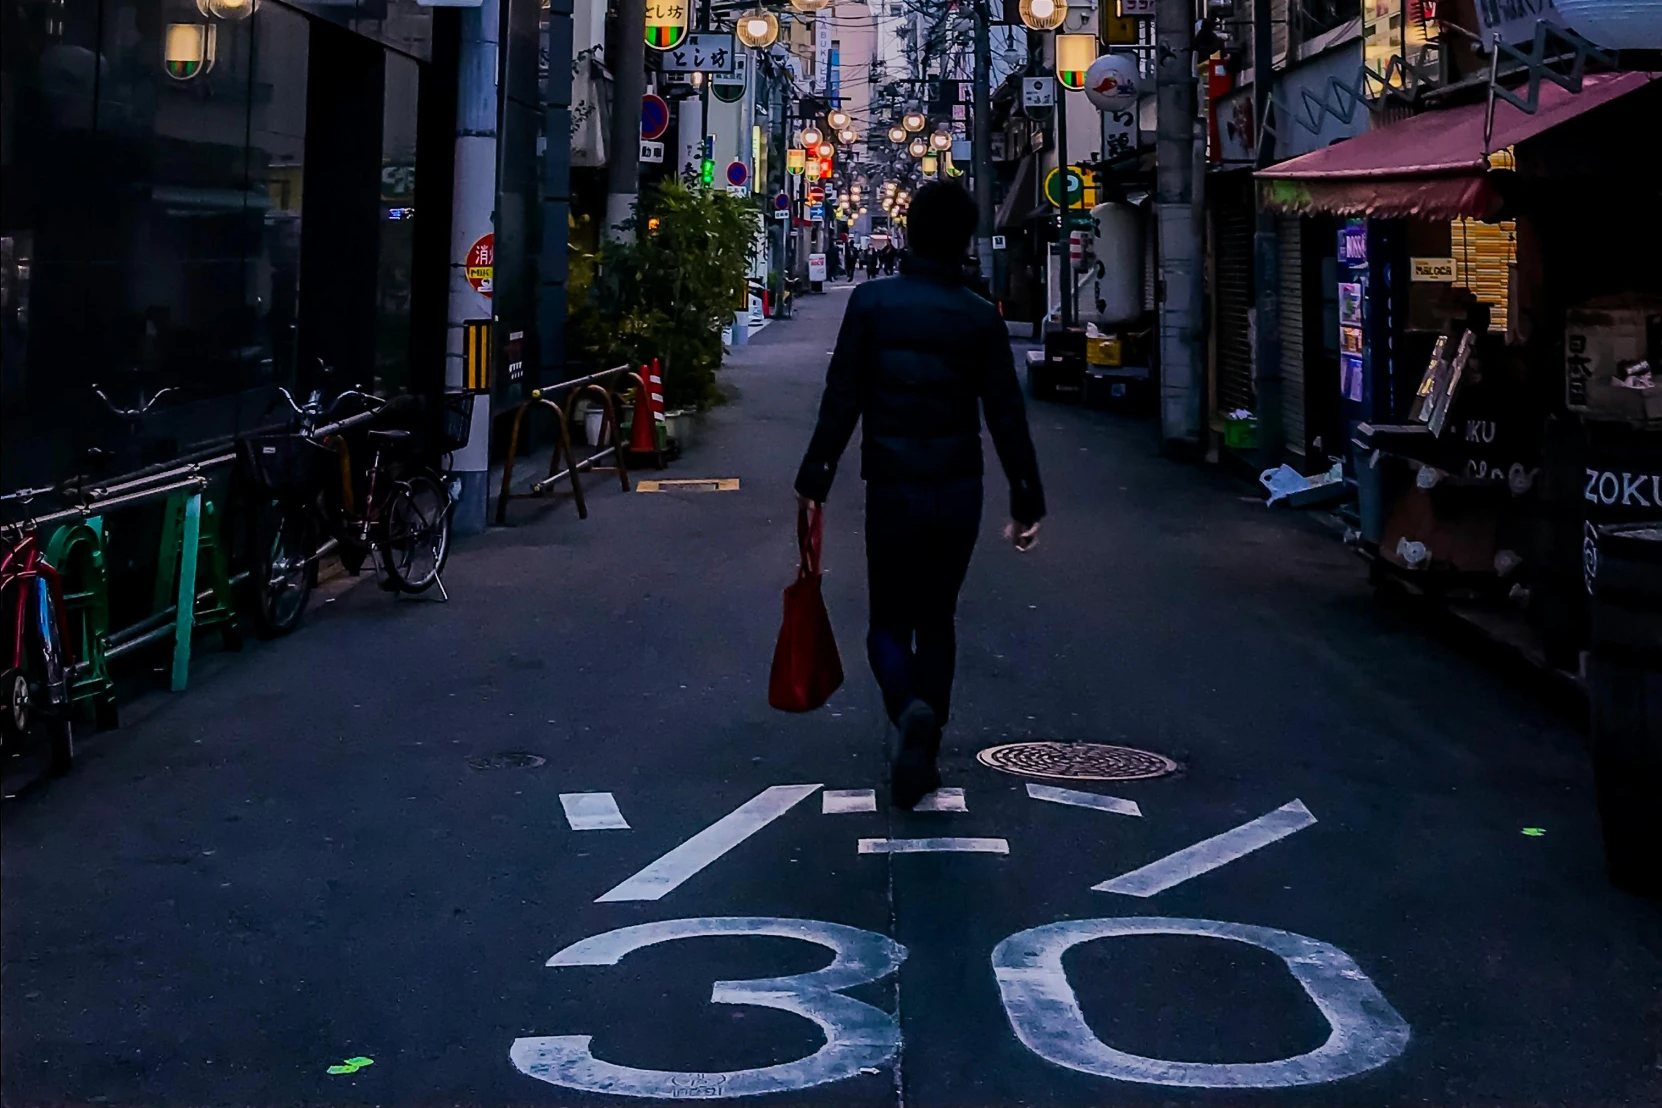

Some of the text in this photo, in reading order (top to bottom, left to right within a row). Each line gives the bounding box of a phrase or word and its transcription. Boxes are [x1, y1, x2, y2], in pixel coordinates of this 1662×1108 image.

[673, 48, 728, 69] とし坊
[509, 916, 1411, 1098] 30
